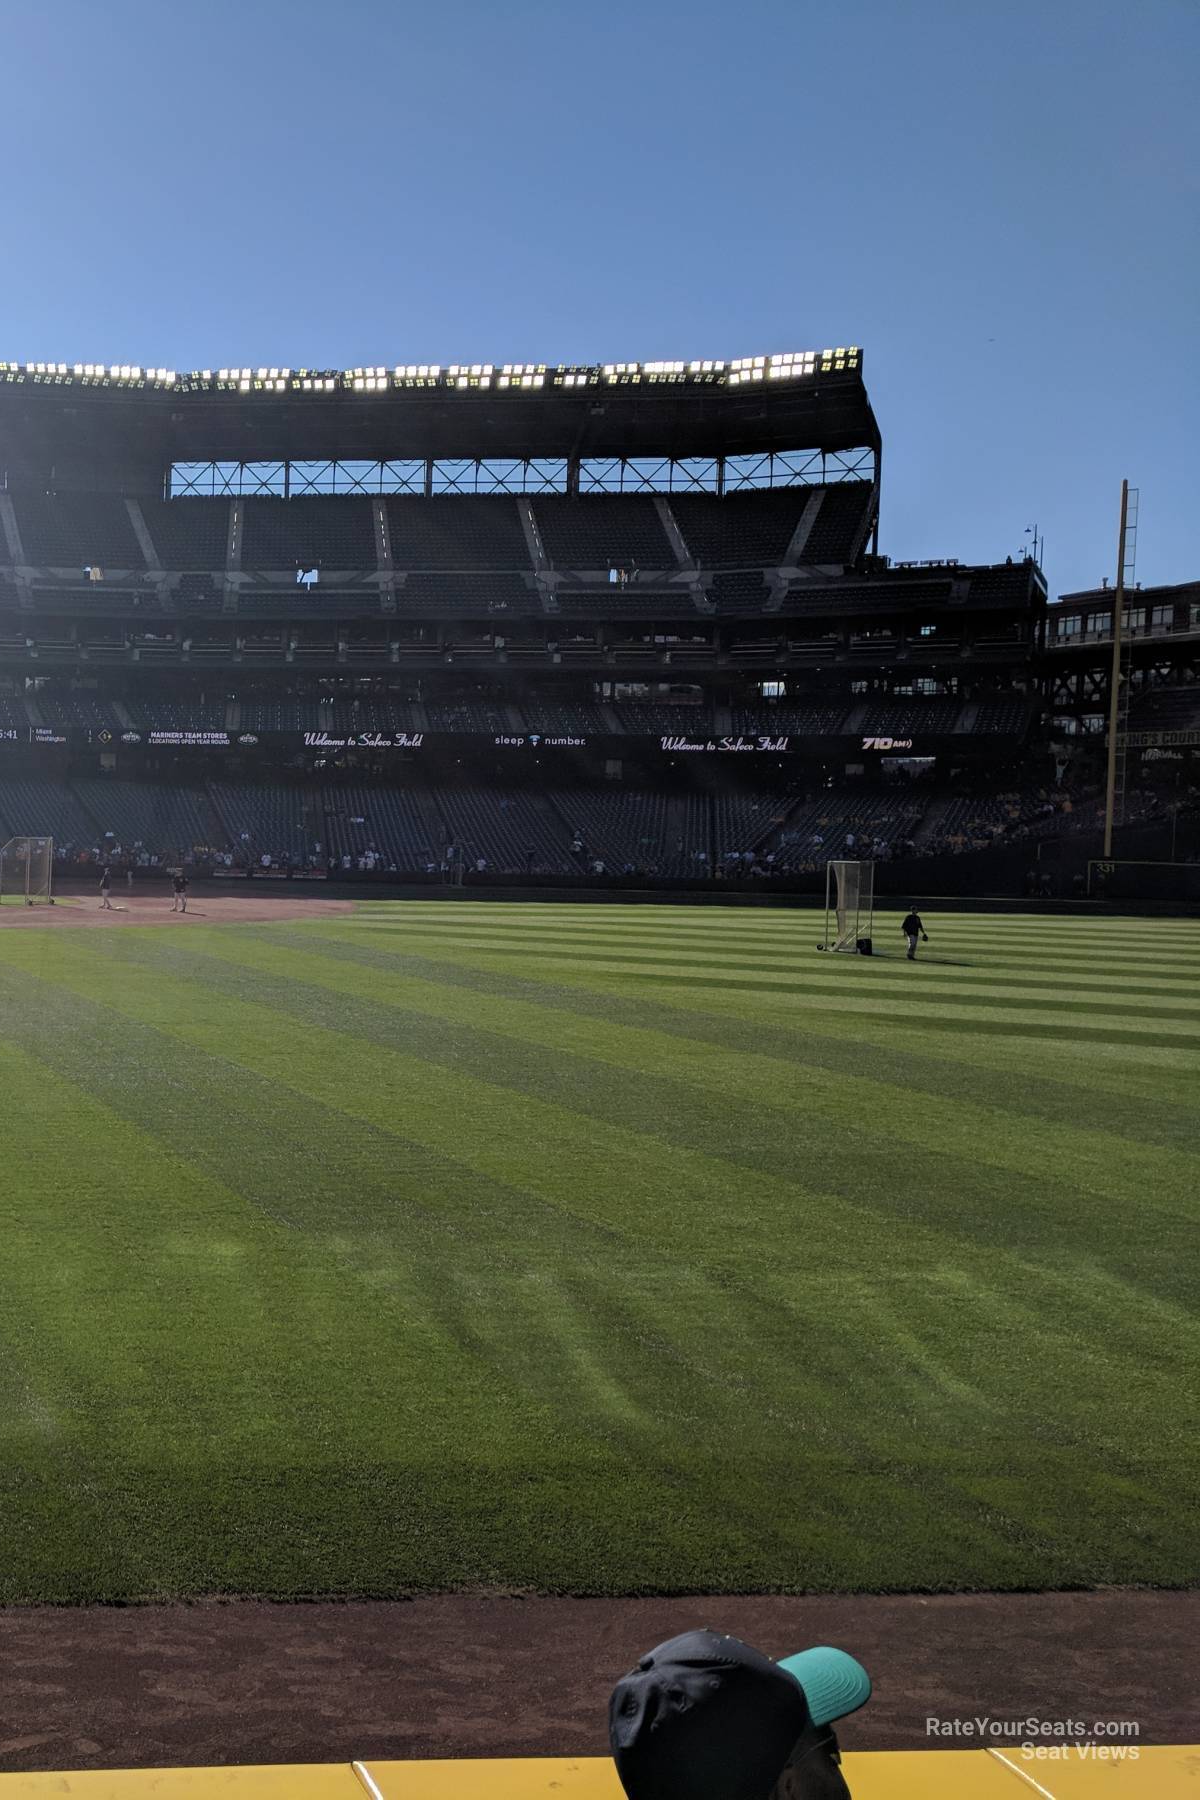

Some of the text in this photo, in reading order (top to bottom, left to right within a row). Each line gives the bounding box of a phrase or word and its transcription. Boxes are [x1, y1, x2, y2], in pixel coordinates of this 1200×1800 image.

[150, 731, 184, 739] MARINERS
[304, 732, 424, 747] Welcome to Safeco Field
[495, 735, 524, 747] sleep
[660, 736, 789, 752] Welcome to Safeco Field
[1096, 863, 1115, 873] 331
